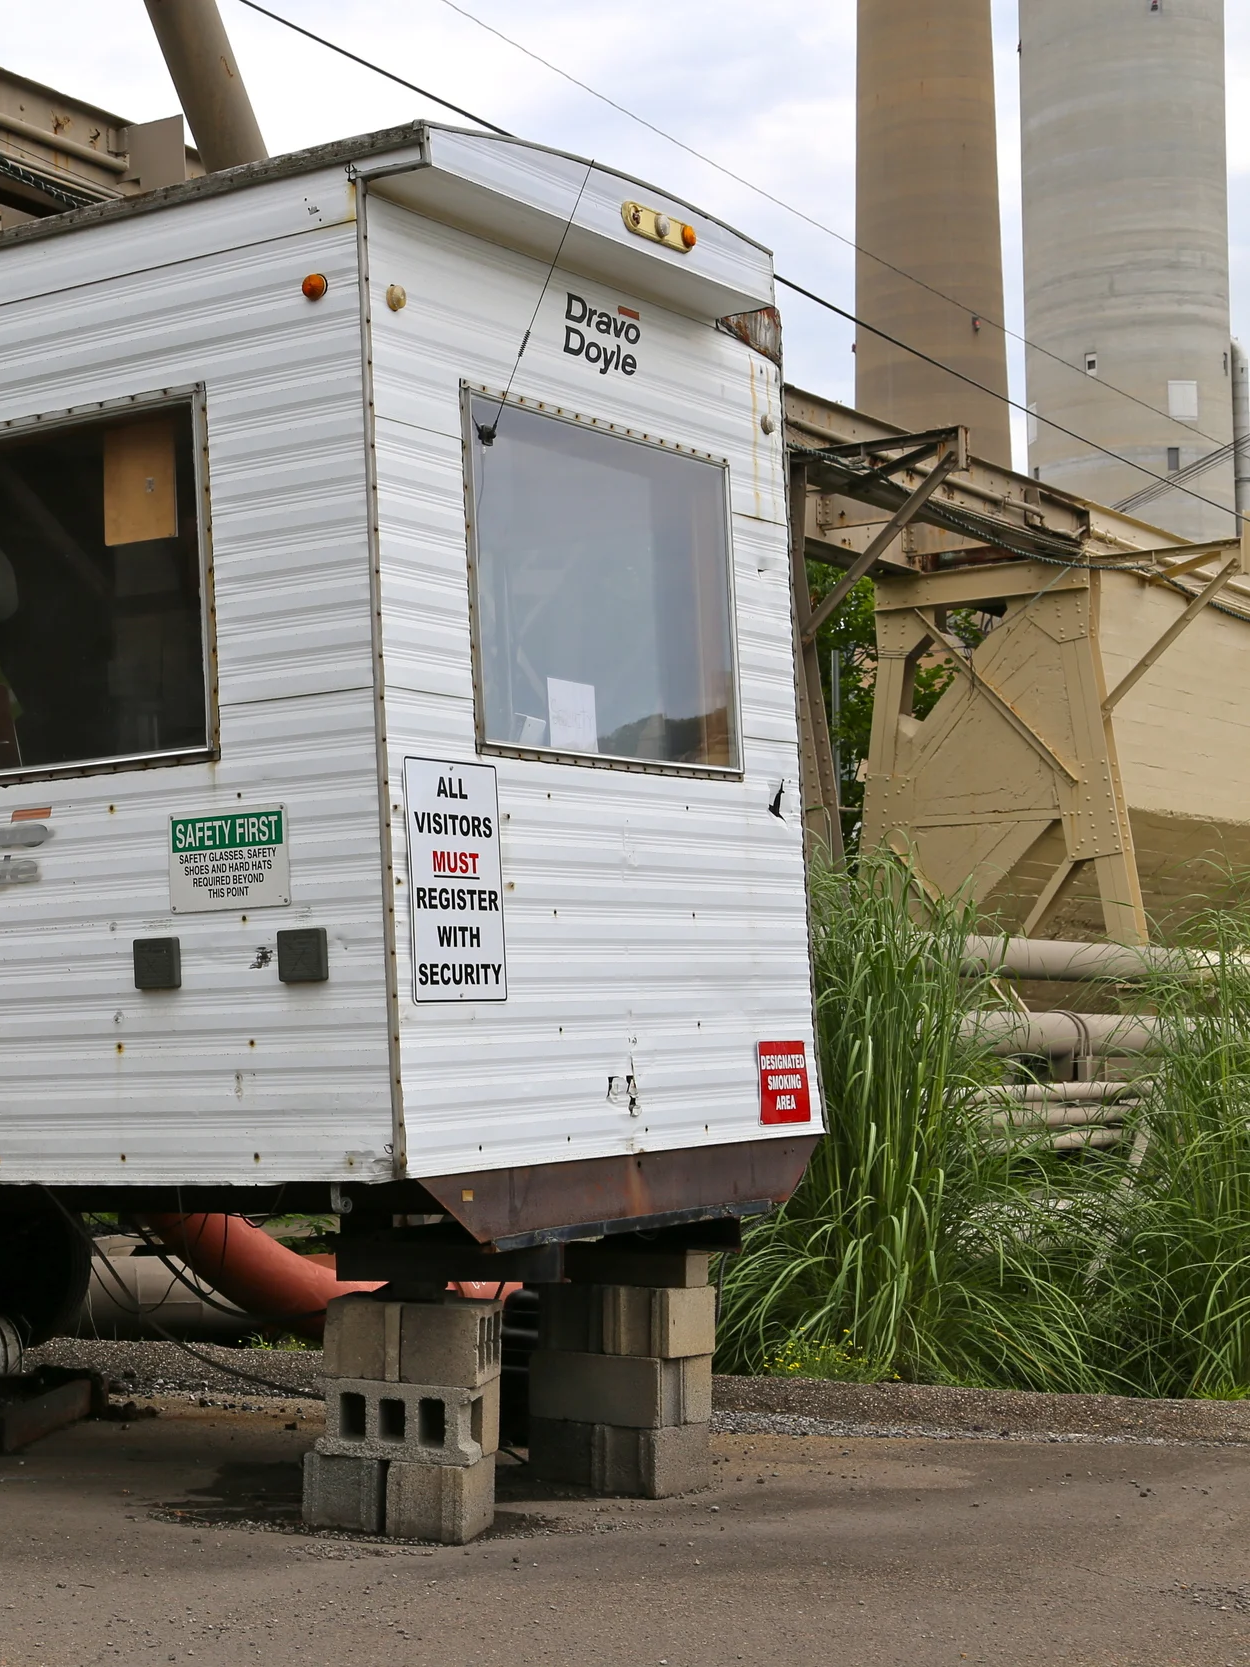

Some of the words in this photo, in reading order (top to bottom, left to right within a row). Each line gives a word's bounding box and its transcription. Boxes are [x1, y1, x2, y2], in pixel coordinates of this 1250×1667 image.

[565, 291, 641, 345] Dravo
[563, 325, 637, 376] Doyle
[437, 776, 468, 800] ALL
[176, 820, 231, 848] SAFETY
[236, 815, 278, 843] FIRST
[414, 811, 493, 838] VISITORS
[179, 853, 207, 865] SAFETY
[210, 849, 246, 862] GLASSES,
[247, 847, 276, 859] SAFETY
[184, 865, 209, 876] SHOES
[211, 863, 227, 874] AND
[229, 861, 250, 873] HARD
[252, 859, 272, 870] HATS
[432, 850, 479, 874] MUST
[193, 875, 230, 888] REQUIRED
[233, 872, 264, 885] BEYOND
[208, 888, 225, 899] THIS
[227, 886, 249, 897] POINT
[416, 887, 499, 911] REGISTER
[437, 925, 481, 948] WITH
[418, 963, 502, 986] SECURITY
[760, 1054, 805, 1070] DESIGNATED
[767, 1074, 802, 1091] SMOKING
[775, 1094, 797, 1110] AREA
